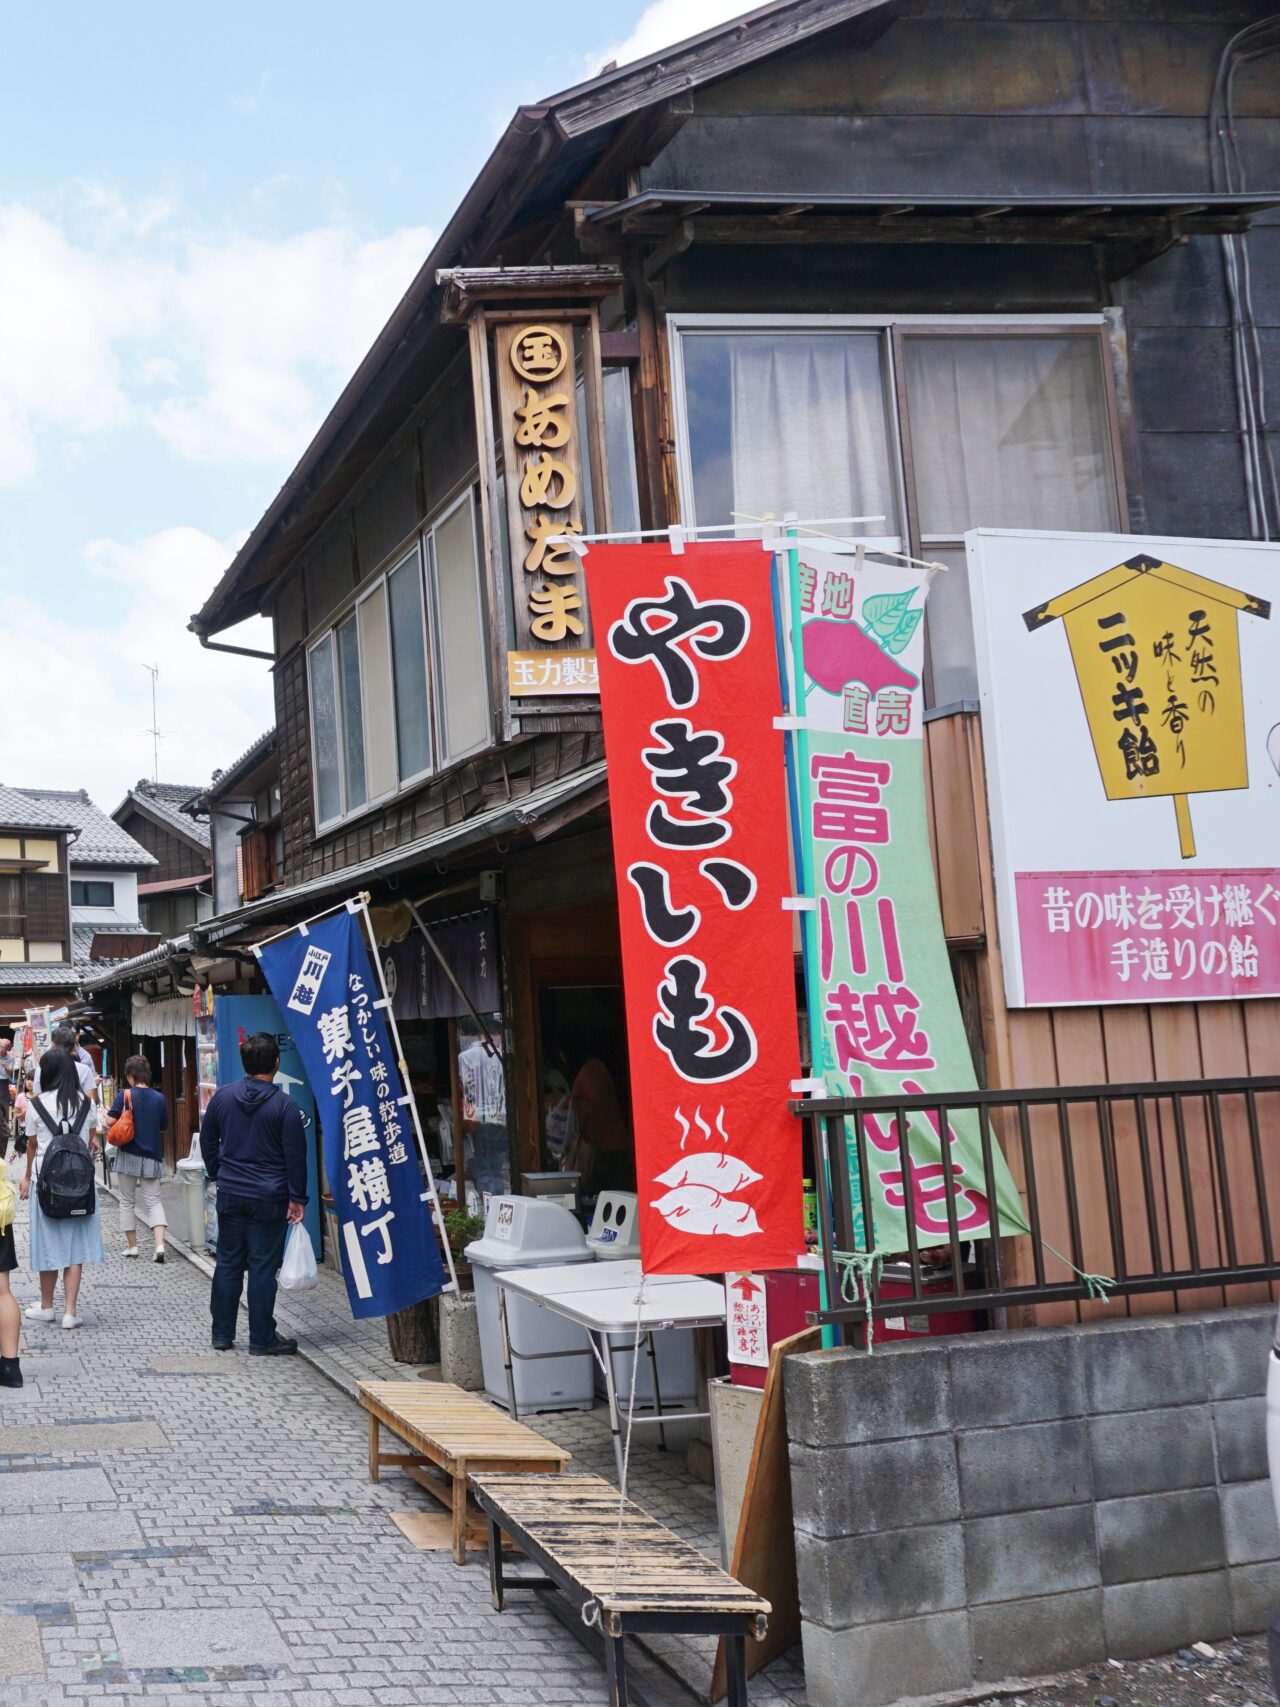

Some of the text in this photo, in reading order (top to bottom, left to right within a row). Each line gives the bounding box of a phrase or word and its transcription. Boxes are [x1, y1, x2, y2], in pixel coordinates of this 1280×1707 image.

[521, 335, 560, 371] 玉
[515, 390, 585, 642] あめだま
[842, 686, 912, 737] 直売
[1096, 611, 1160, 781] ニッキ飴
[1152, 630, 1189, 770] 味と香り
[1185, 609, 1220, 717] 天然の
[608, 575, 758, 1084] やきいも
[1041, 882, 1279, 934] 昔の味を受け継ぐ
[1110, 932, 1259, 982] 手造りの飴
[292, 960, 324, 1006] 川越
[809, 750, 992, 1236] 富の川越いも
[316, 1003, 396, 1265] 菓子屋横丁
